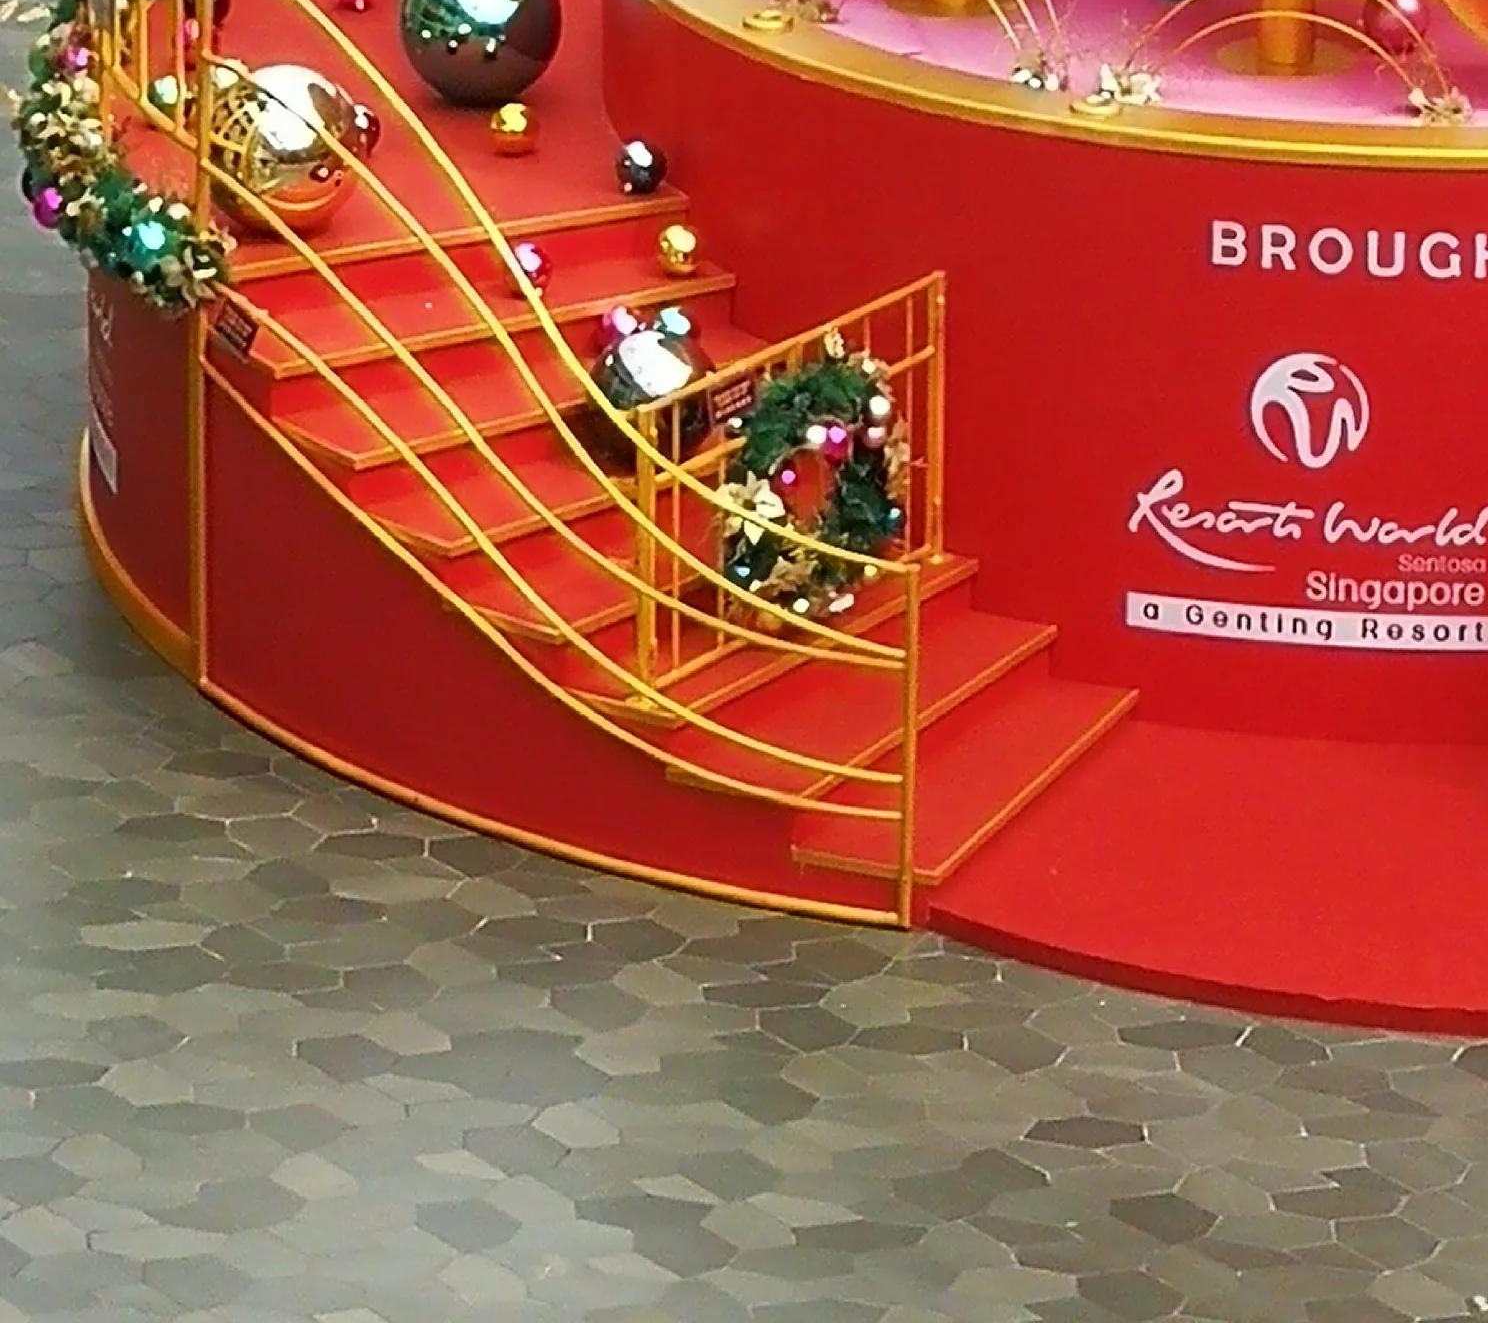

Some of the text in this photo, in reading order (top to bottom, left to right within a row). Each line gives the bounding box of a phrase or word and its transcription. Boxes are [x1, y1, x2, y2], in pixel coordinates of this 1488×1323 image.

[1128, 467, 1488, 572] Resorts World
[1397, 554, 1487, 573] Sentosa
[1305, 570, 1486, 611] Singapore
[1142, 602, 1485, 643] a Genting Resort
